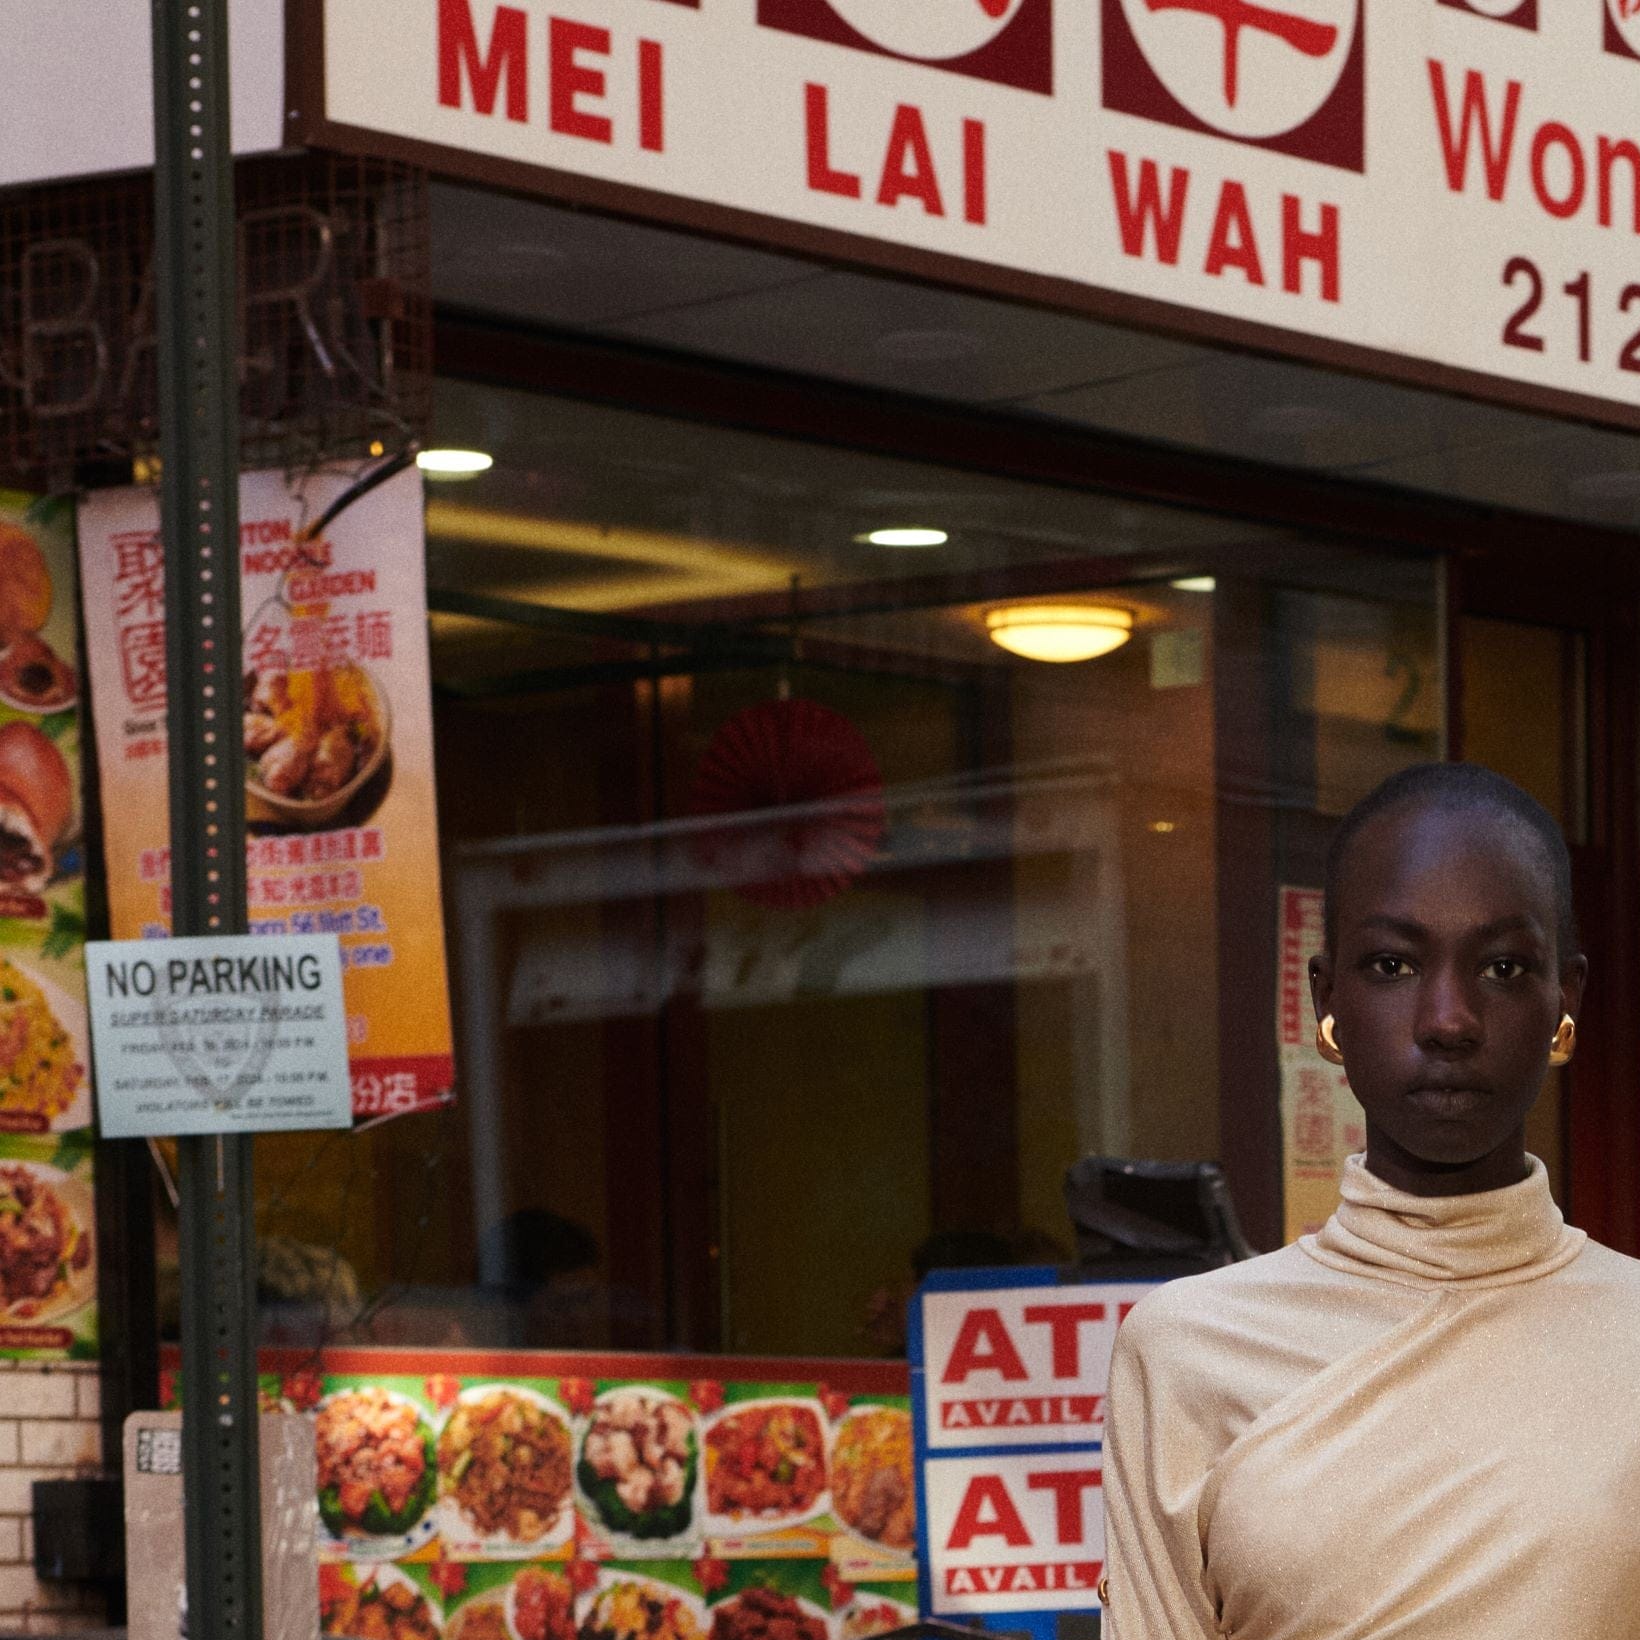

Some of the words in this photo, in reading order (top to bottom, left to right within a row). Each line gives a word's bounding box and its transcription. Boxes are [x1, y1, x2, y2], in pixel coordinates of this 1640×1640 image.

[436, 0, 664, 153] MEI
[803, 82, 988, 226] LAI
[1107, 150, 1343, 305] WAH
[239, 518, 291, 545] TON
[107, 961, 155, 997] NO
[168, 954, 321, 994] PARKING
[941, 1303, 1133, 1385] AT
